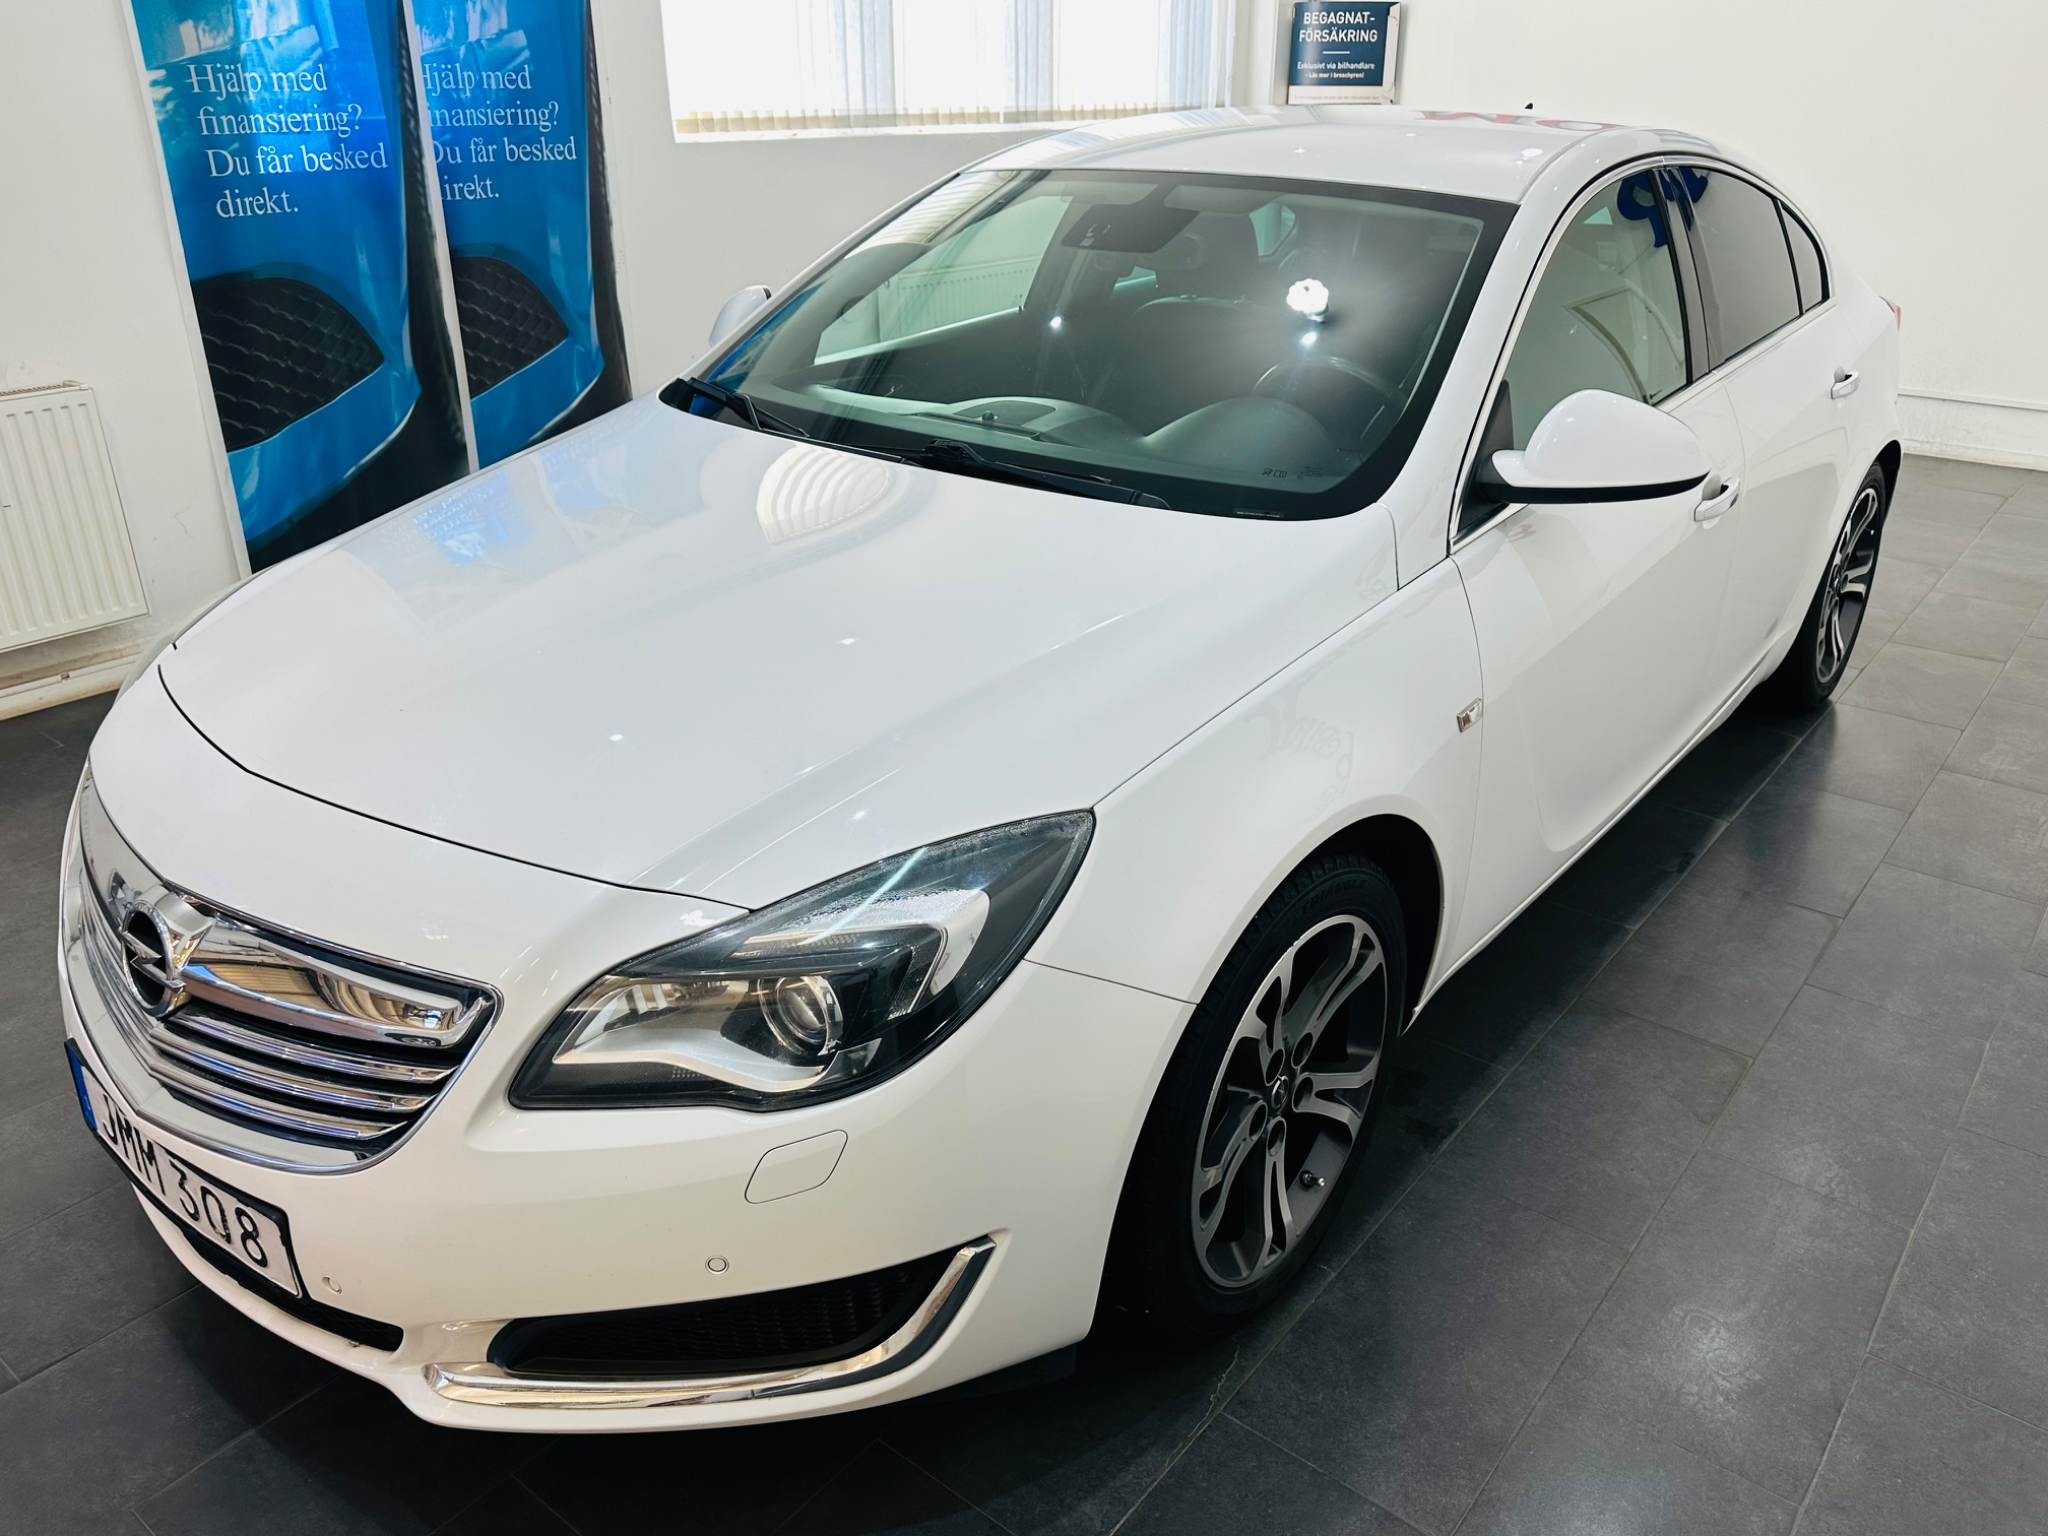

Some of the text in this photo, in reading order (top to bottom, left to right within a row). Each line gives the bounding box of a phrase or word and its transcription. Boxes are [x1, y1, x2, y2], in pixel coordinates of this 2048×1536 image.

[1303, 11, 1375, 25] BEGAGNAT-
[1299, 27, 1378, 42] FÖRSÄKRING
[481, 64, 532, 90] med
[1297, 61, 1375, 69] Exklusivt via bilhandlare
[186, 63, 328, 101] Hjälp med
[197, 103, 362, 138] finansiering?
[427, 100, 559, 132] inansiering?
[205, 142, 388, 177] Du får besked
[469, 137, 497, 163] får
[503, 136, 577, 161] besked
[441, 174, 500, 200] irekt.
[216, 187, 299, 218] direkt.
[103, 1093, 268, 1268] JMM 308
